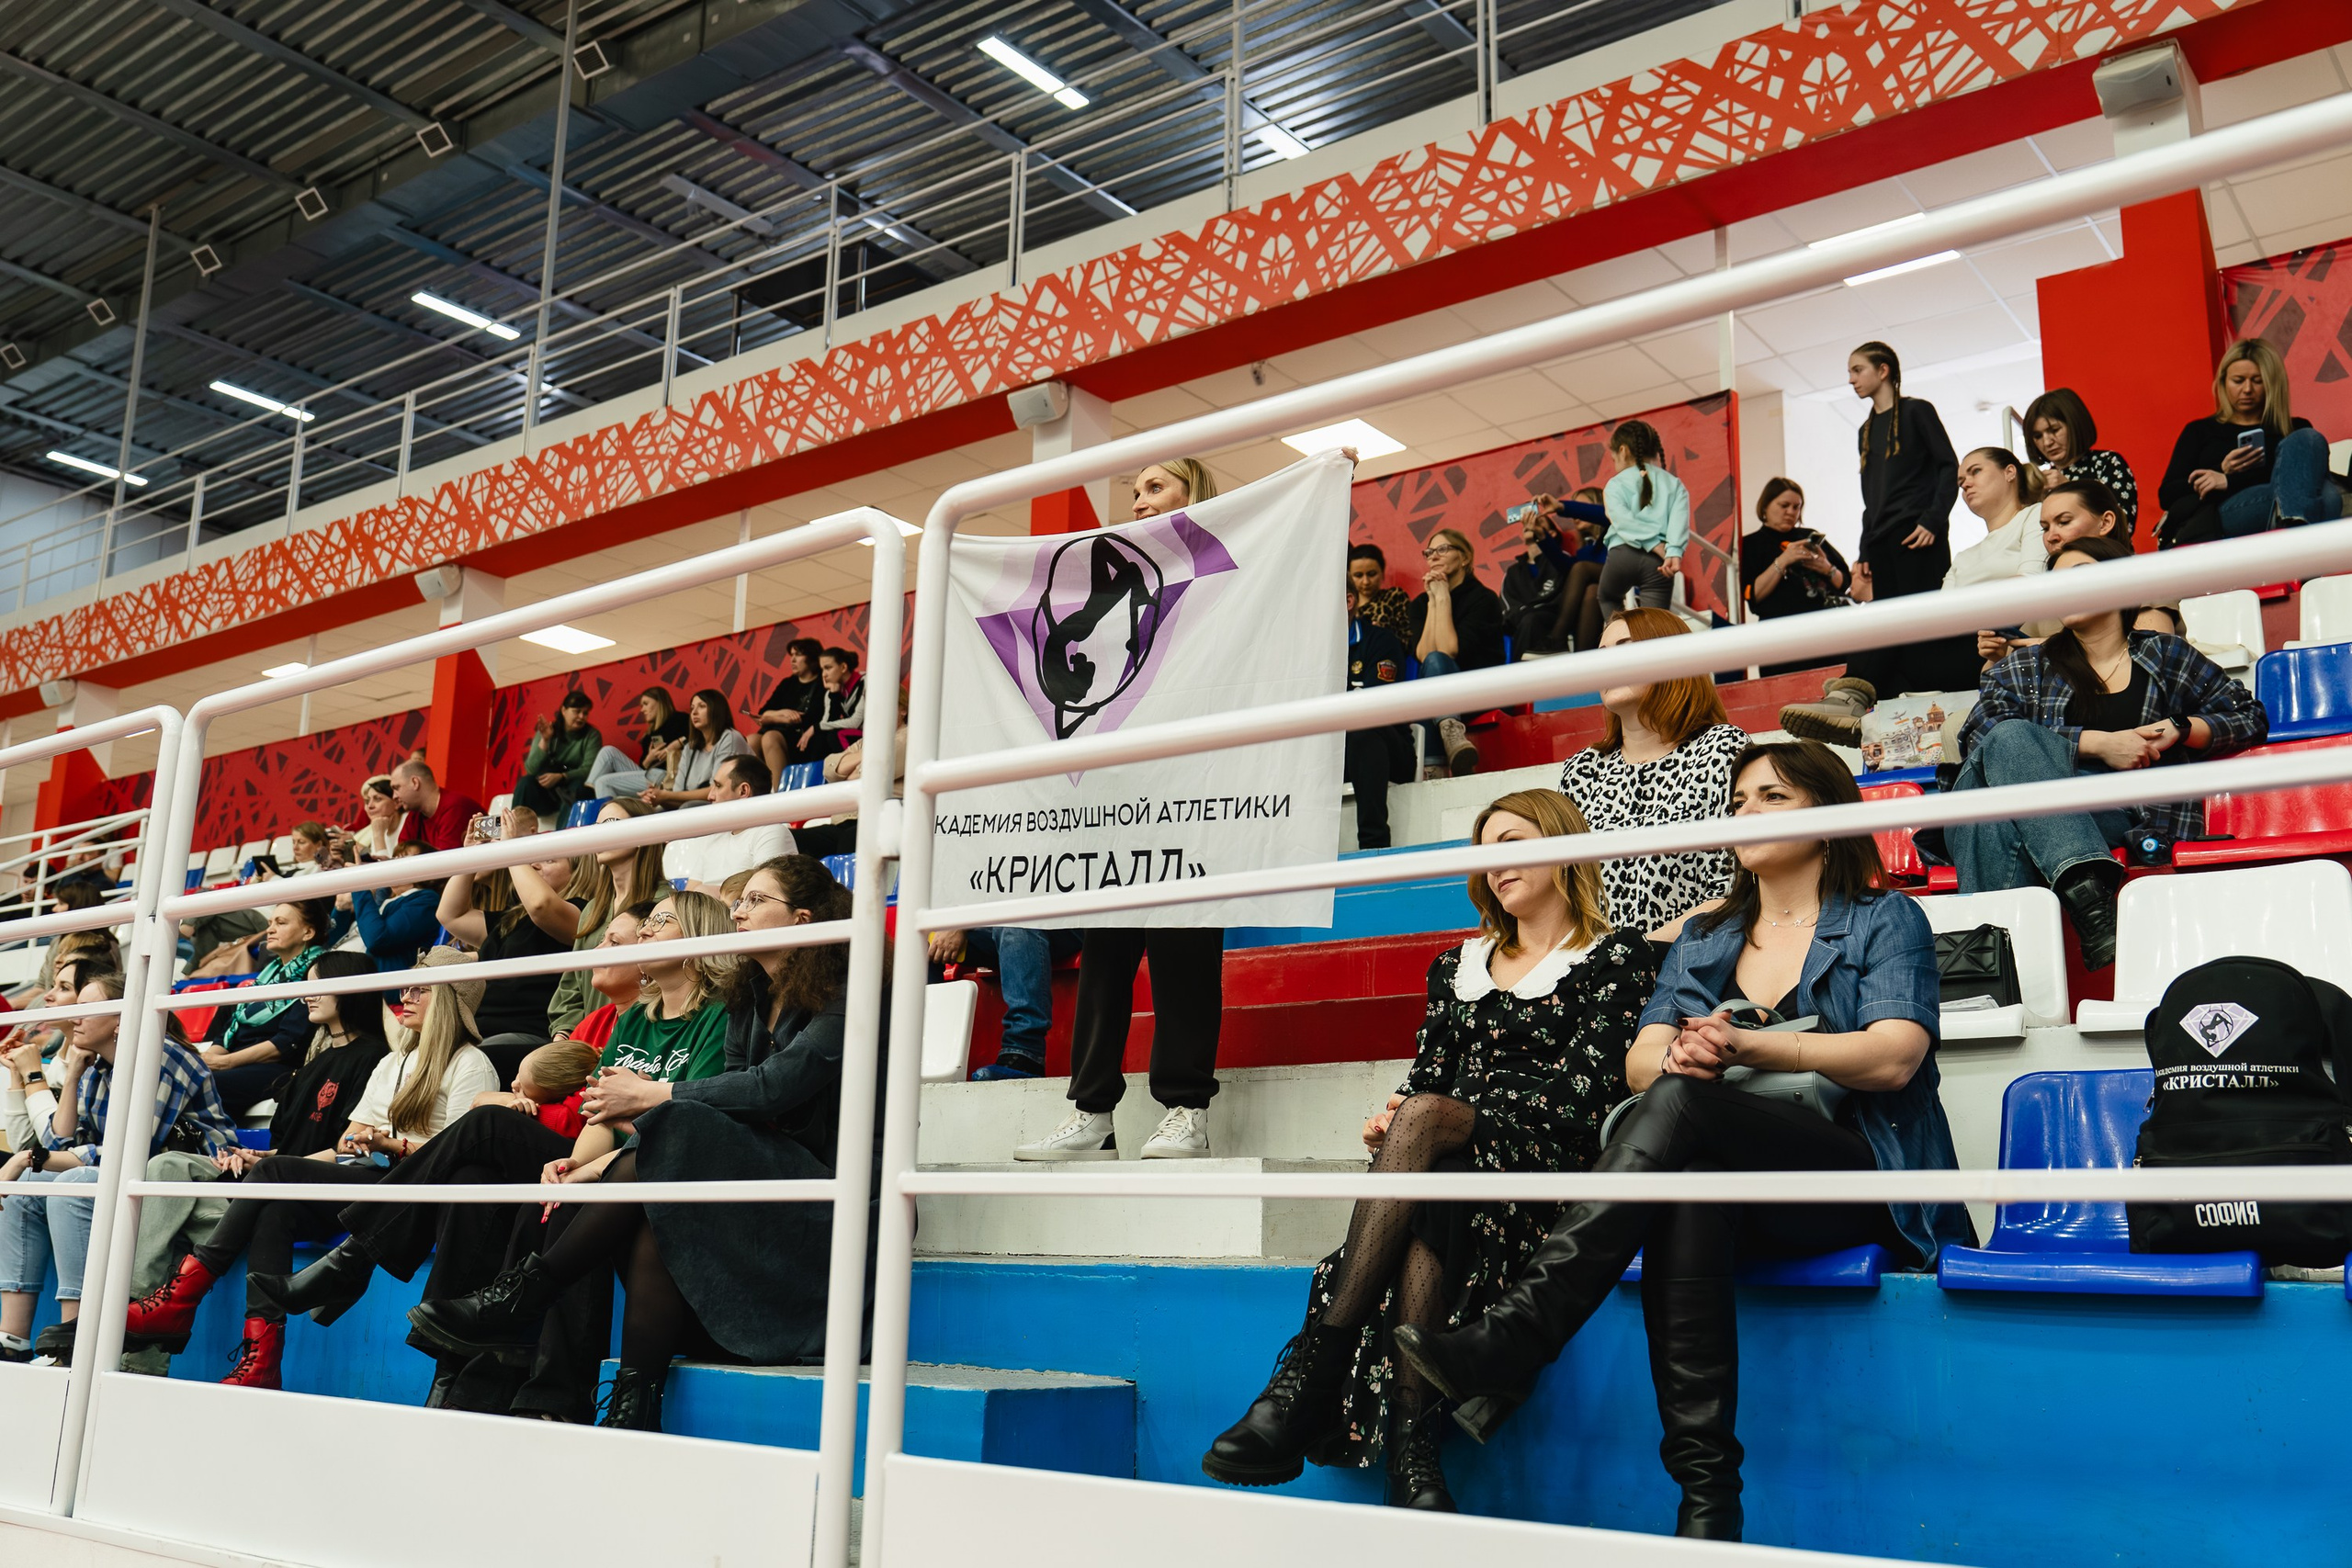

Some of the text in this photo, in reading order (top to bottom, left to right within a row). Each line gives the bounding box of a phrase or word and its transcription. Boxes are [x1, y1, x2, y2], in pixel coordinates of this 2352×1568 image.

[933, 794, 1291, 838] КАДЕМИЯ ВОЗДУШНОЙ АТЛЕТИКИ
[969, 848, 1207, 894] «КРИСТАЛЛ»
[2190, 1062, 2248, 1074] воздушной
[2250, 1064, 2300, 1074] атлетики
[2162, 1074, 2279, 1091] «КРИСТАЛЛ»
[2195, 1201, 2261, 1227] СОФИЯ
